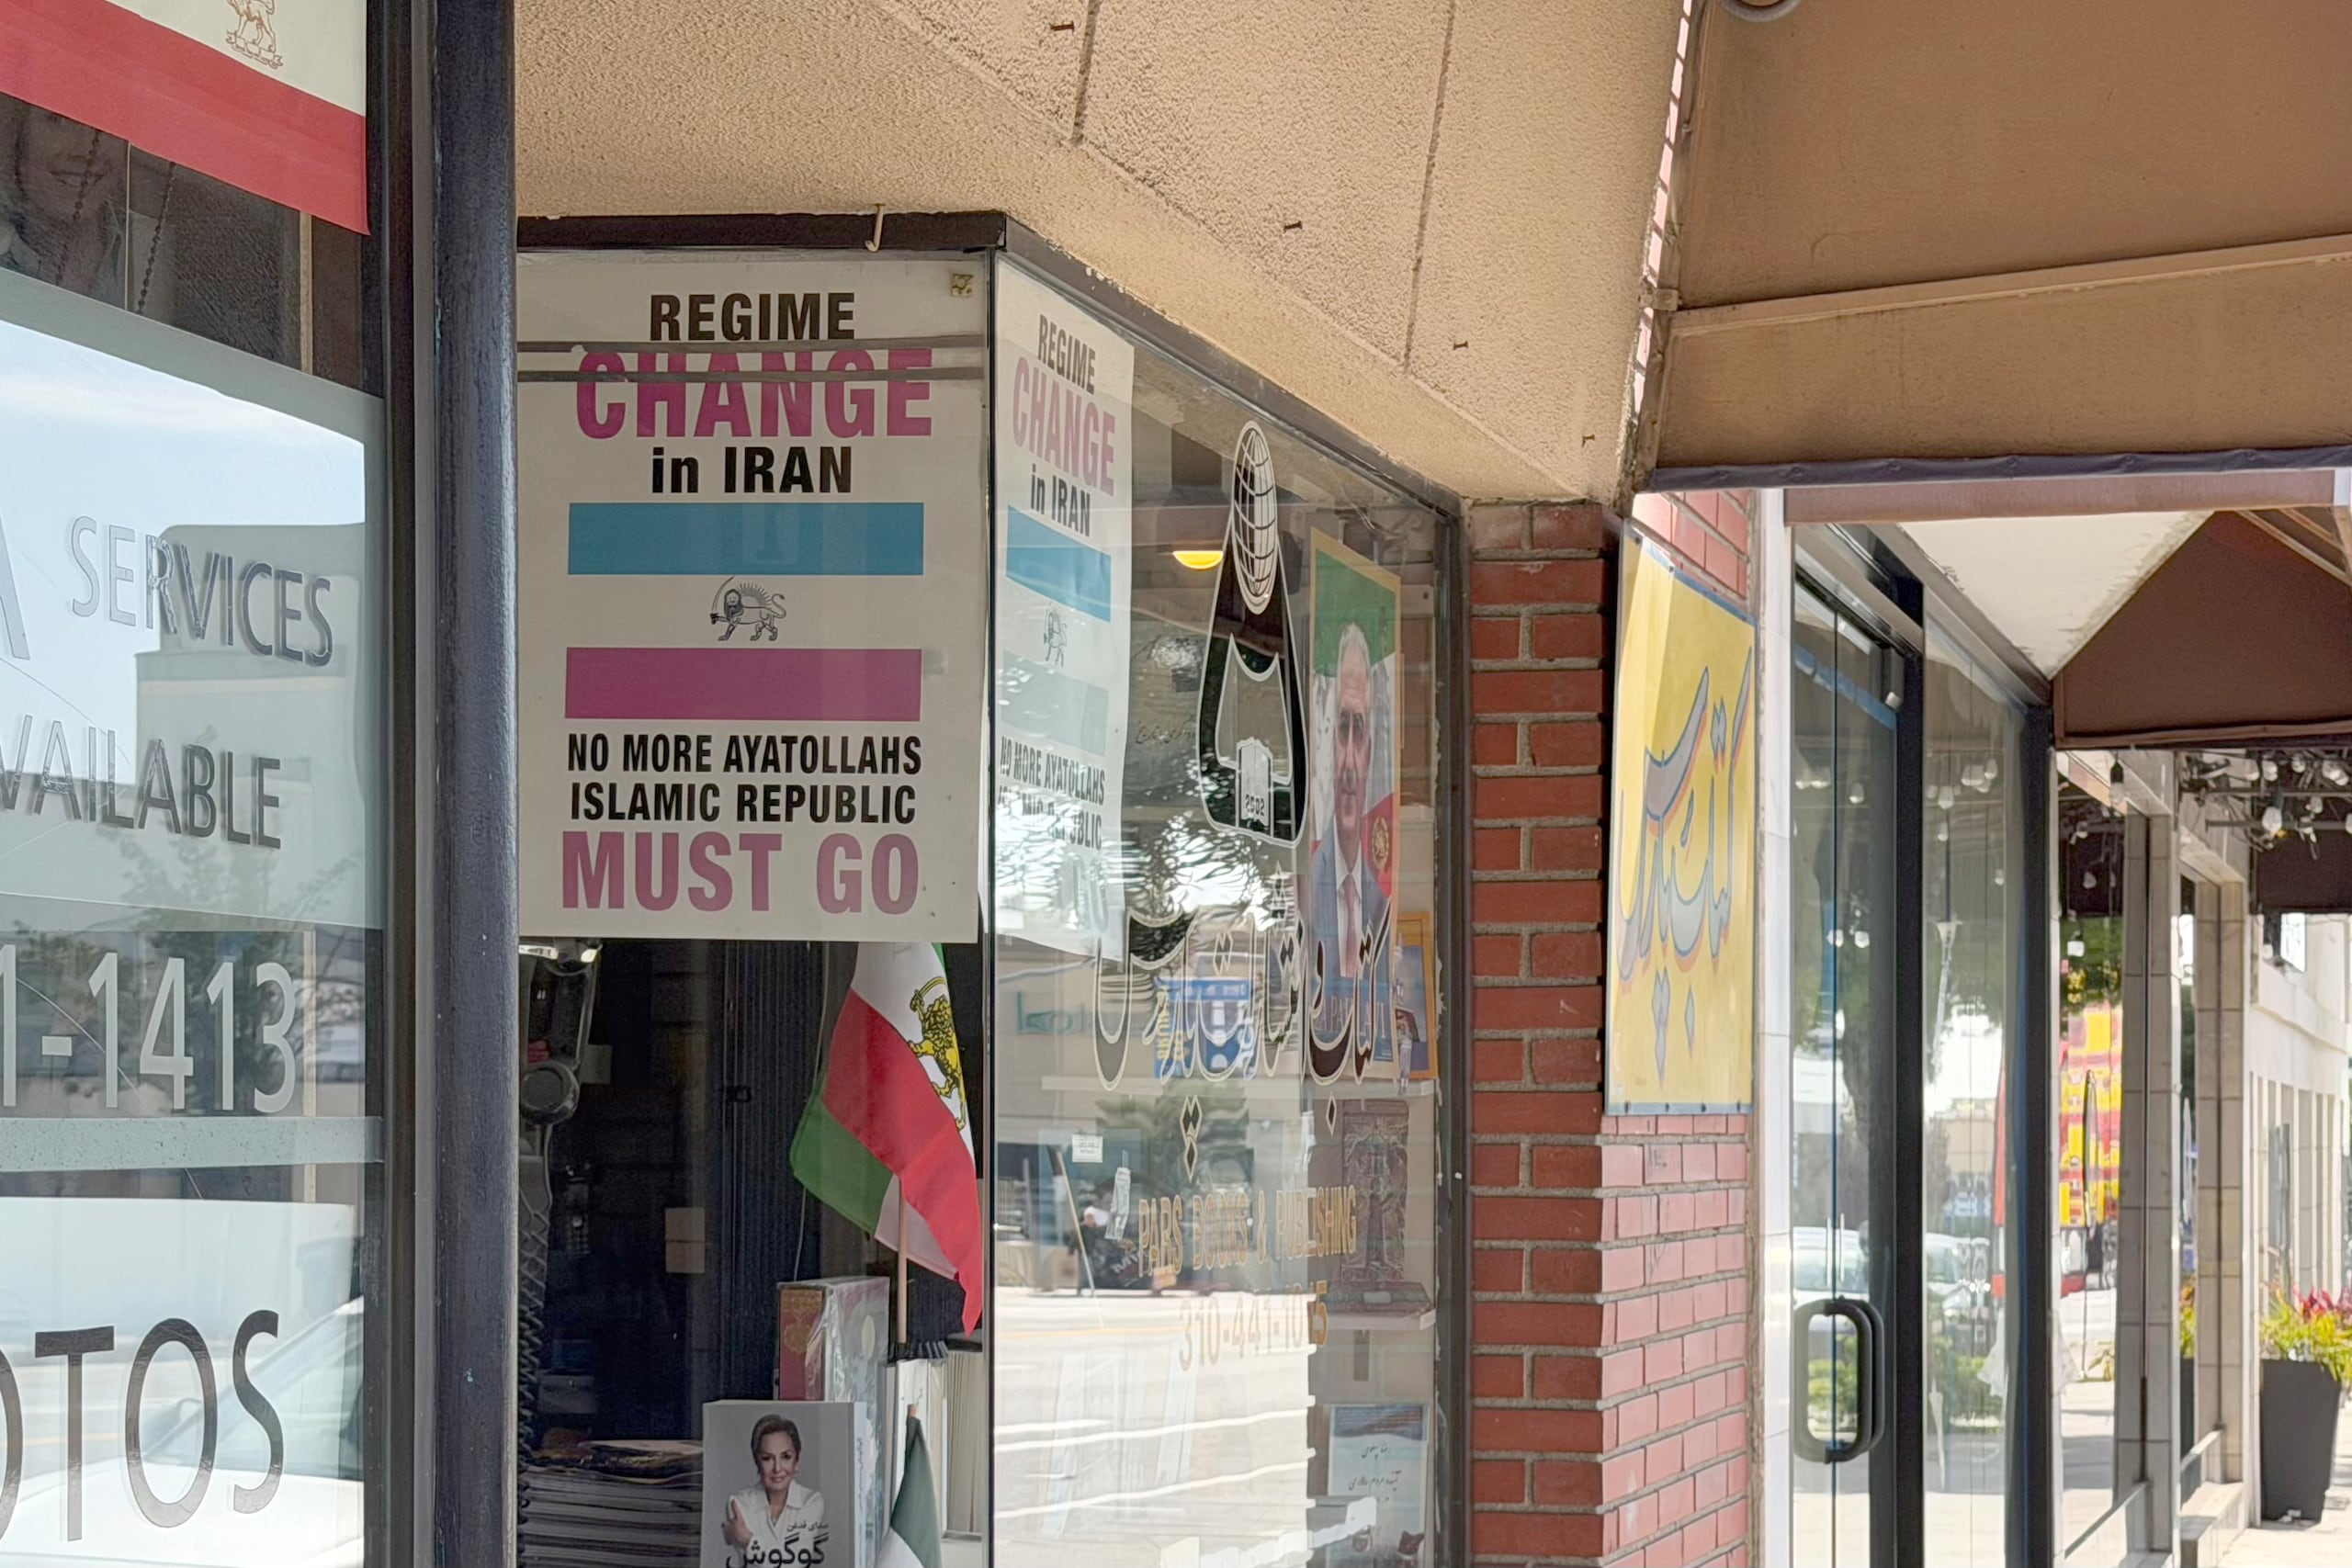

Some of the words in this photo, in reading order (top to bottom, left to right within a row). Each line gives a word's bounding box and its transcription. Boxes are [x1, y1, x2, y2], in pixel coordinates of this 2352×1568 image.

[650, 292, 855, 342] REGIME
[1037, 313, 1096, 396] REGIME
[575, 347, 933, 439] CHANGE
[1012, 355, 1116, 497] CHANGE
[651, 446, 699, 493] in
[724, 446, 853, 494] IRAN
[1030, 463, 1046, 515] in
[1052, 475, 1091, 537] IRAN
[71, 514, 334, 667] SERVICES
[568, 733, 609, 773] NO
[623, 734, 713, 773] MORE
[723, 735, 922, 775] AYATOLLAHS
[1000, 736, 1012, 777] NO
[1013, 741, 1042, 787] MORE
[1044, 752, 1106, 807] AYATOLLAHS
[571, 782, 720, 822] ISLAMIC
[736, 784, 917, 825] REPUBLIC
[561, 830, 783, 912] MUST
[815, 832, 920, 915] GO
[1138, 1195, 1183, 1279] PARS
